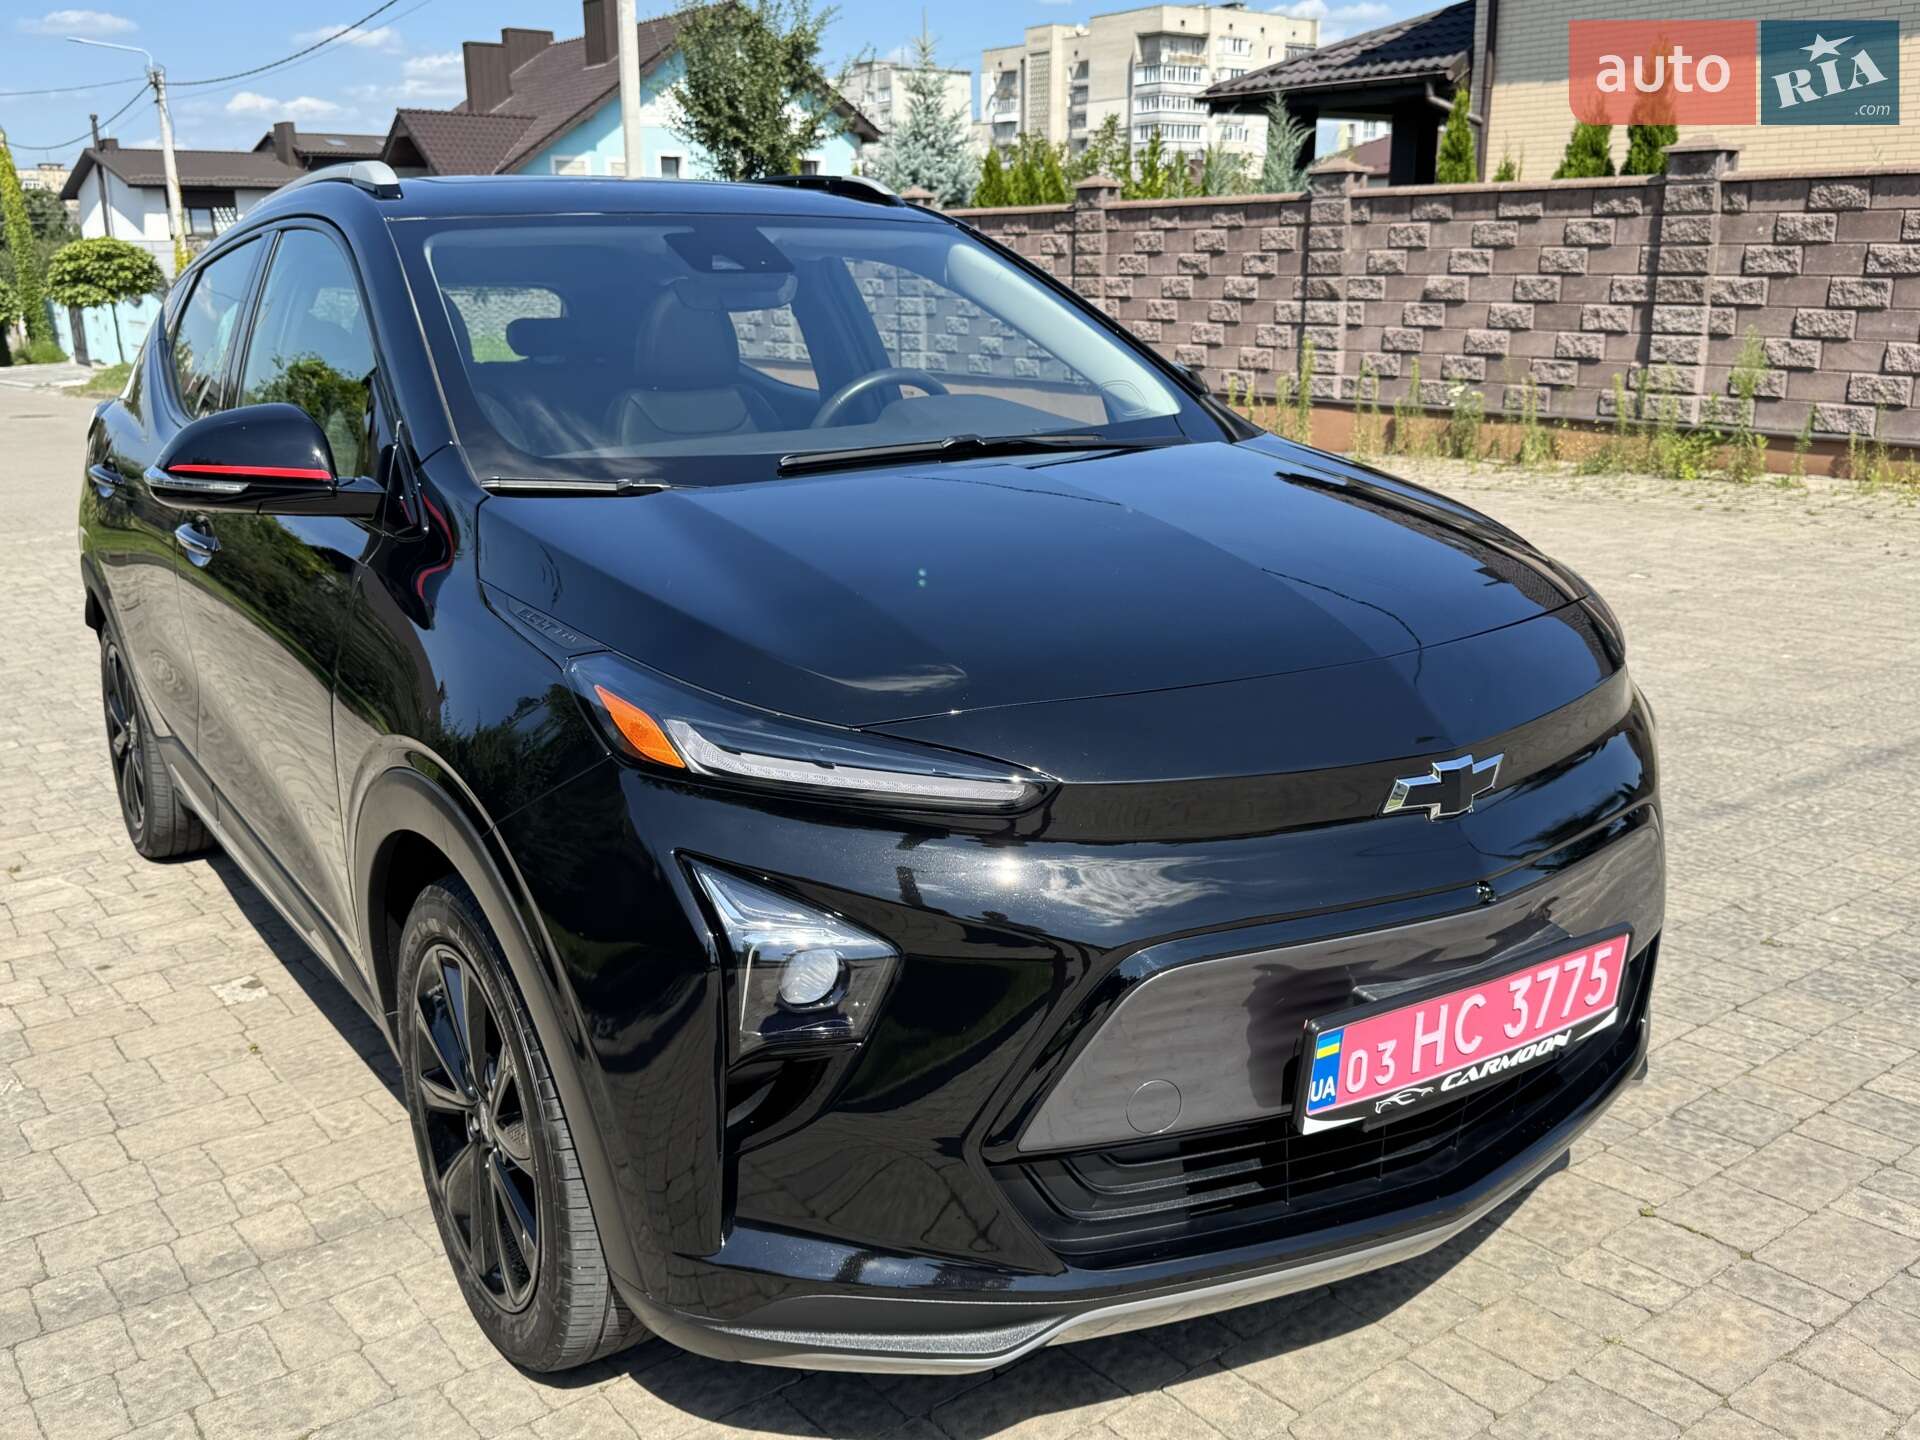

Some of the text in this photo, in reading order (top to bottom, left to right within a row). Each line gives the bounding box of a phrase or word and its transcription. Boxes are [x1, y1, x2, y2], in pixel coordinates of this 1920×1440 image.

[1346, 947, 1613, 1093] 03 HC 3775
[1311, 1075, 1336, 1101] UA
[1440, 1029, 1571, 1092] CARMOON
